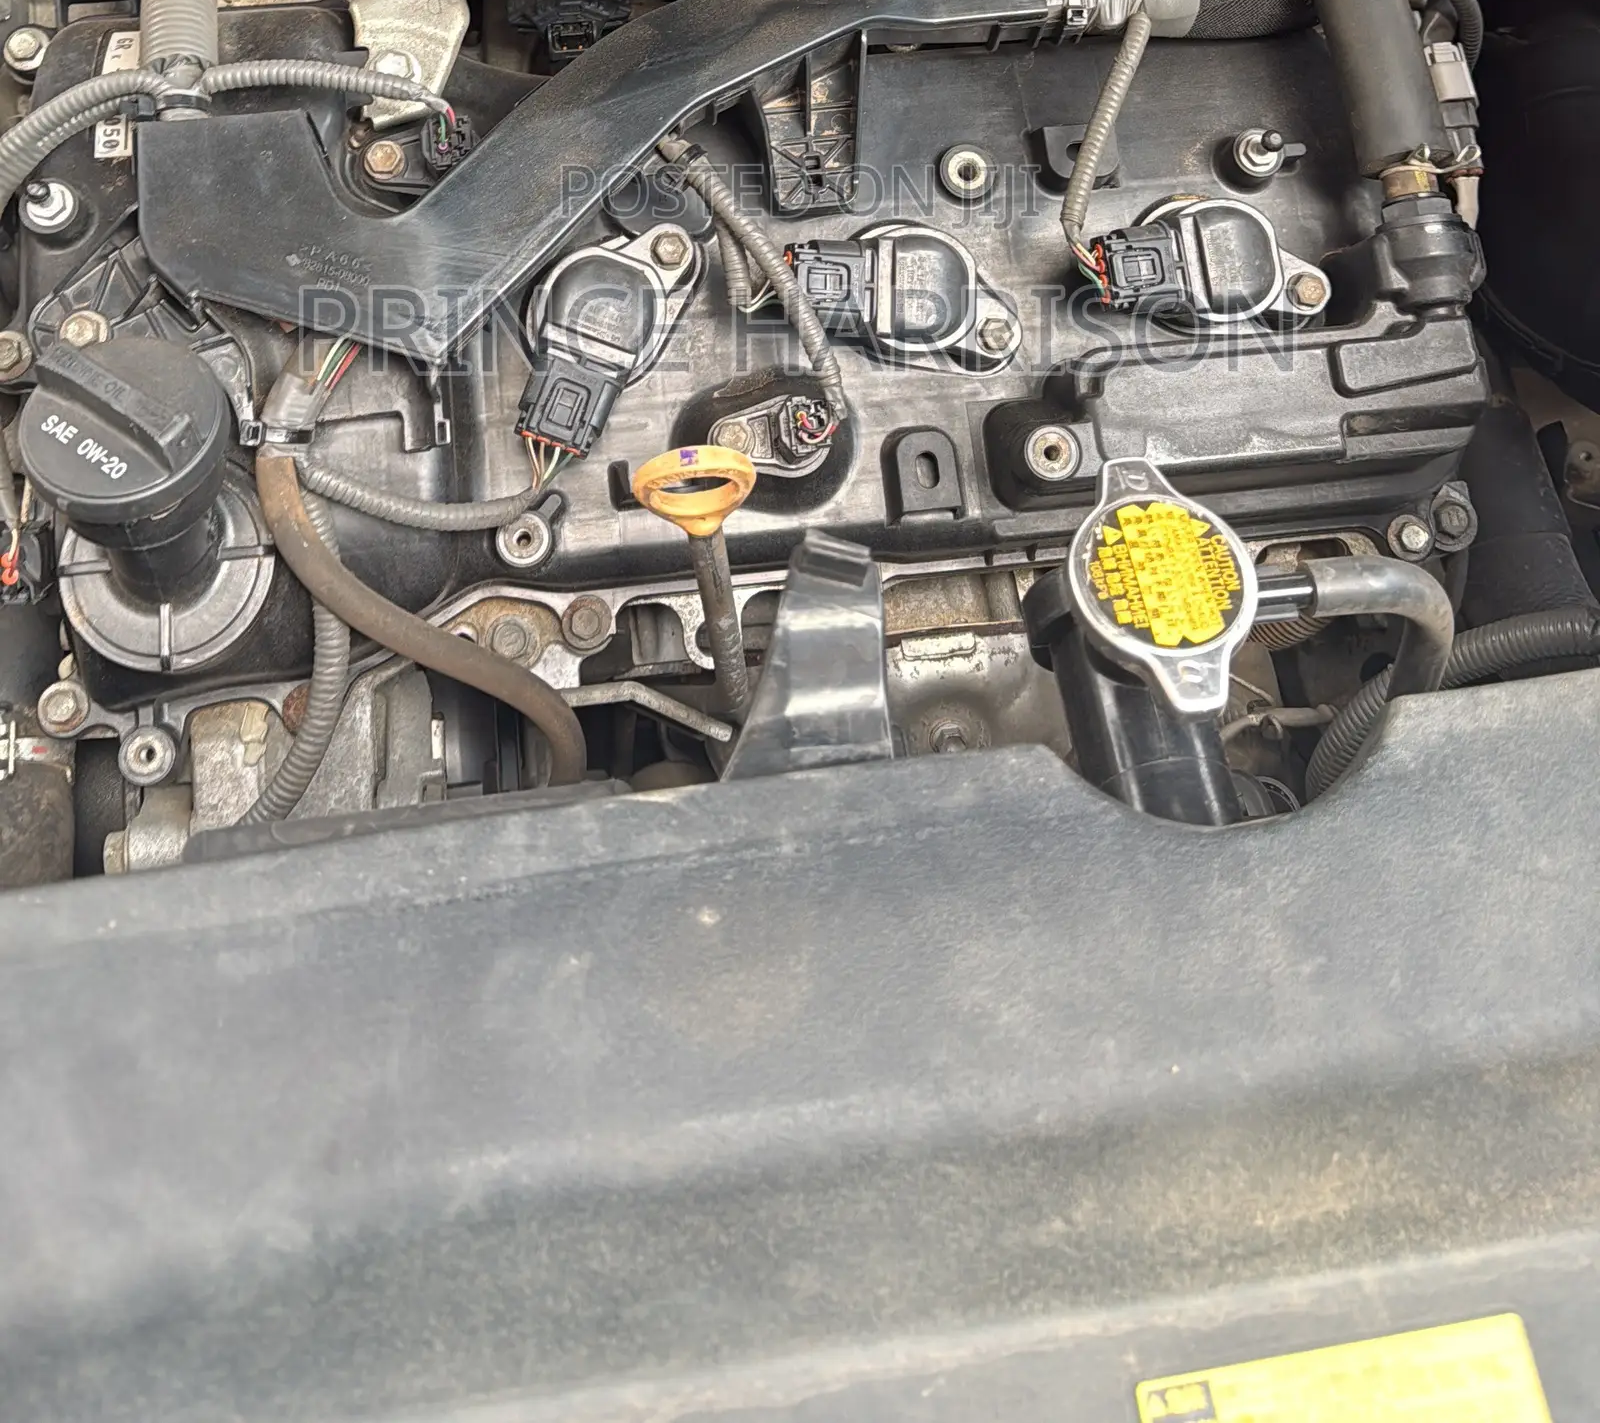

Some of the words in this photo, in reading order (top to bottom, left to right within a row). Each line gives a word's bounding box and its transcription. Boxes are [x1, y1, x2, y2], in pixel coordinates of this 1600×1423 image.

[40, 414, 78, 445] SAE
[76, 438, 128, 479] 0W-20
[1112, 543, 1151, 629] ВНИМАНИЕ!
[1197, 537, 1233, 611] ATTENTION
[1211, 534, 1241, 592] CAUTION
